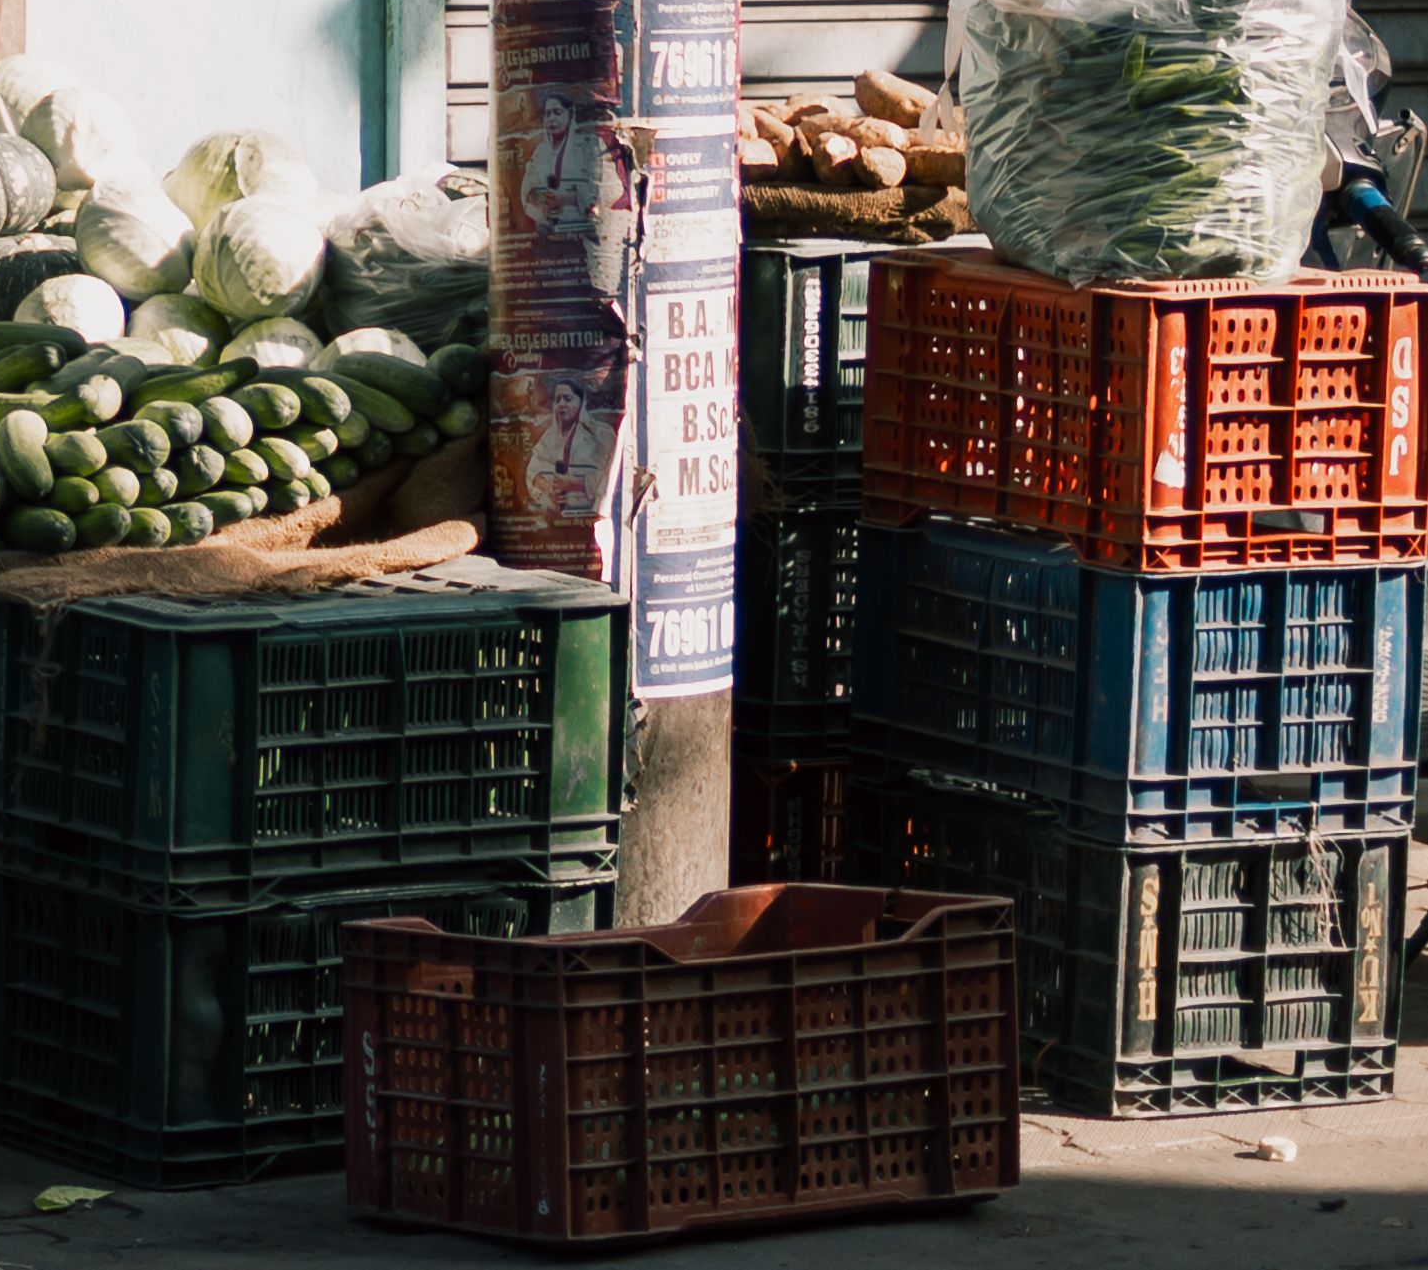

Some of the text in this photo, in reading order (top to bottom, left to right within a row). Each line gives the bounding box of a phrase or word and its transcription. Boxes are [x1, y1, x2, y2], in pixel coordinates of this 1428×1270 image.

[668, 299, 714, 340] B.A.
[664, 350, 714, 392] BCA
[790, 549, 811, 653] TRADERS
